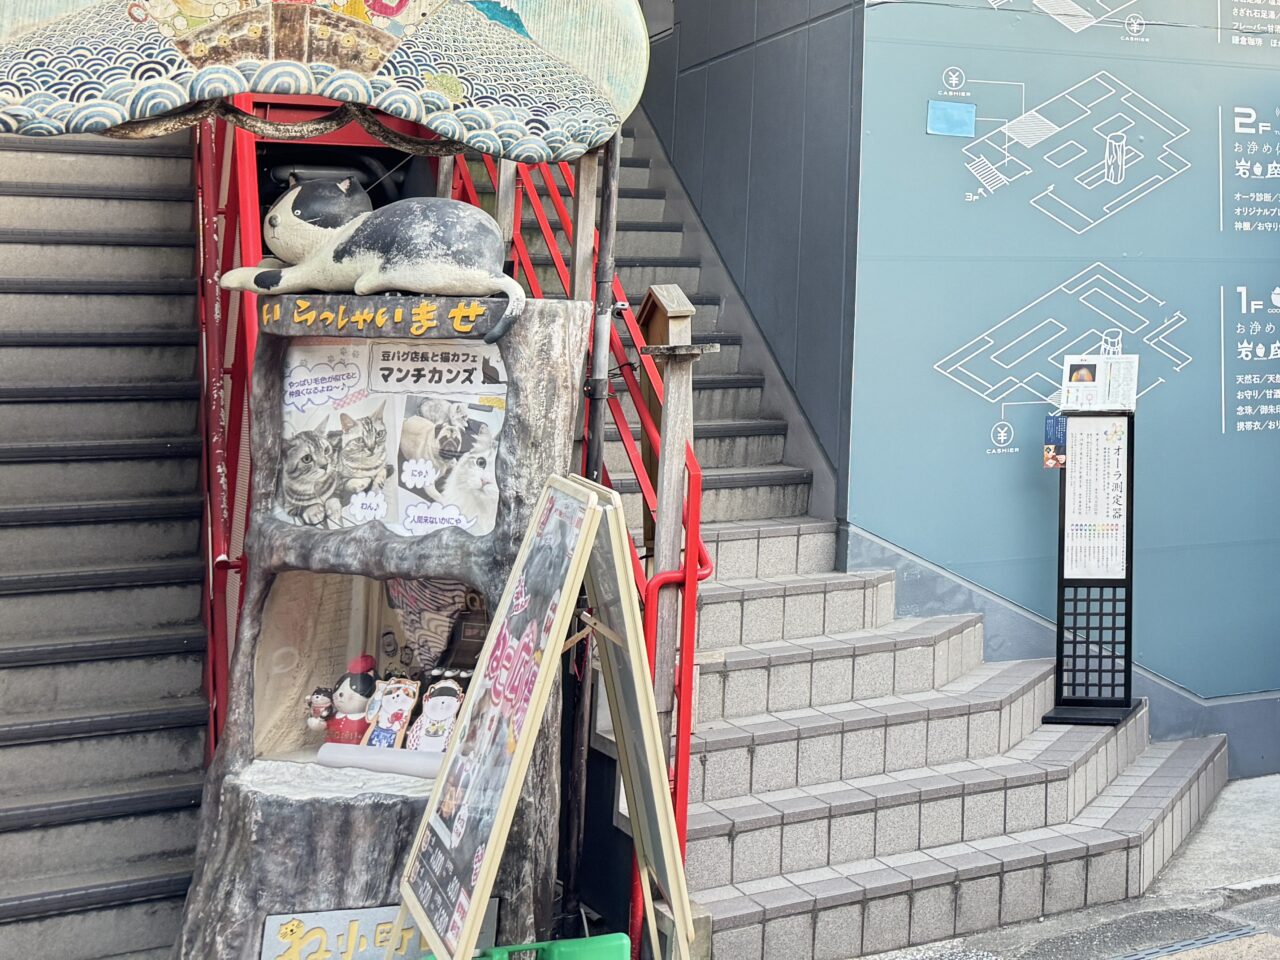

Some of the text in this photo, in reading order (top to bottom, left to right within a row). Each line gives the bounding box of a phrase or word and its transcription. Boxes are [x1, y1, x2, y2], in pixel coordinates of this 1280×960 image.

[1234, 106, 1272, 135] 2F
[1236, 285, 1264, 314] 1F
[261, 299, 488, 336] いらっしゃいませ
[379, 366, 478, 385] マンチカンズ
[986, 447, 1020, 455] CASHIER
[1111, 445, 1123, 520] オーラ測定器
